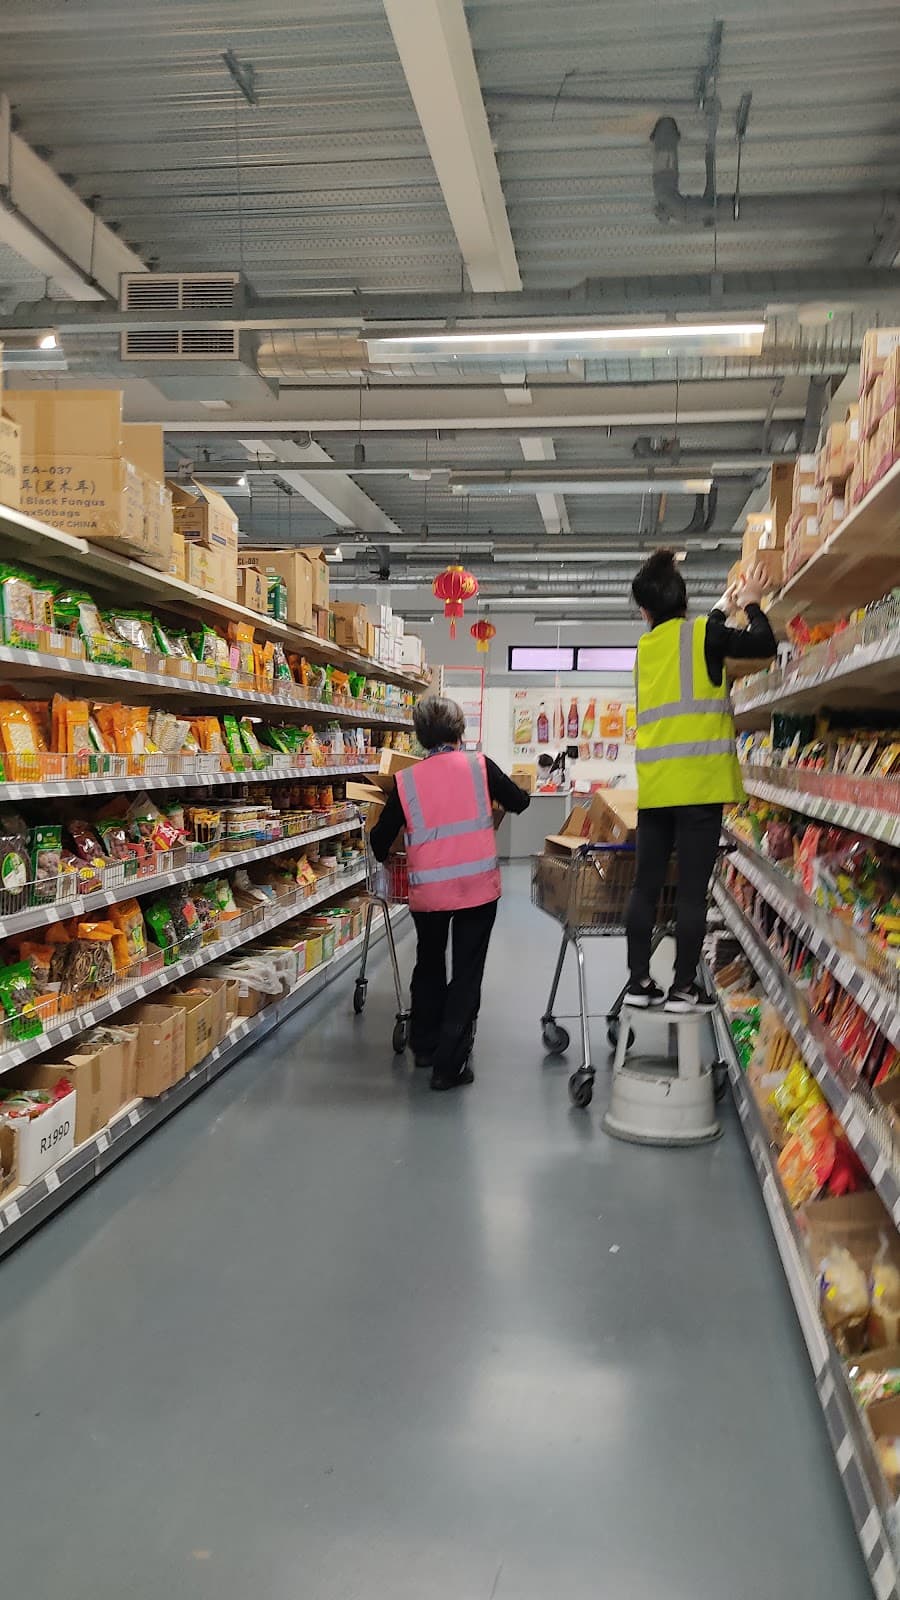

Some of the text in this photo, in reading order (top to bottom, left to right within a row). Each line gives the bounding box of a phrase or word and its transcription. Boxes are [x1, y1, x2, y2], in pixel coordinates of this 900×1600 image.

[22, 465, 73, 475] EA-037
[26, 497, 59, 506] Black
[61, 497, 105, 507] Fungus
[66, 520, 97, 529] CHINA
[40, 1120, 70, 1154] R199D
